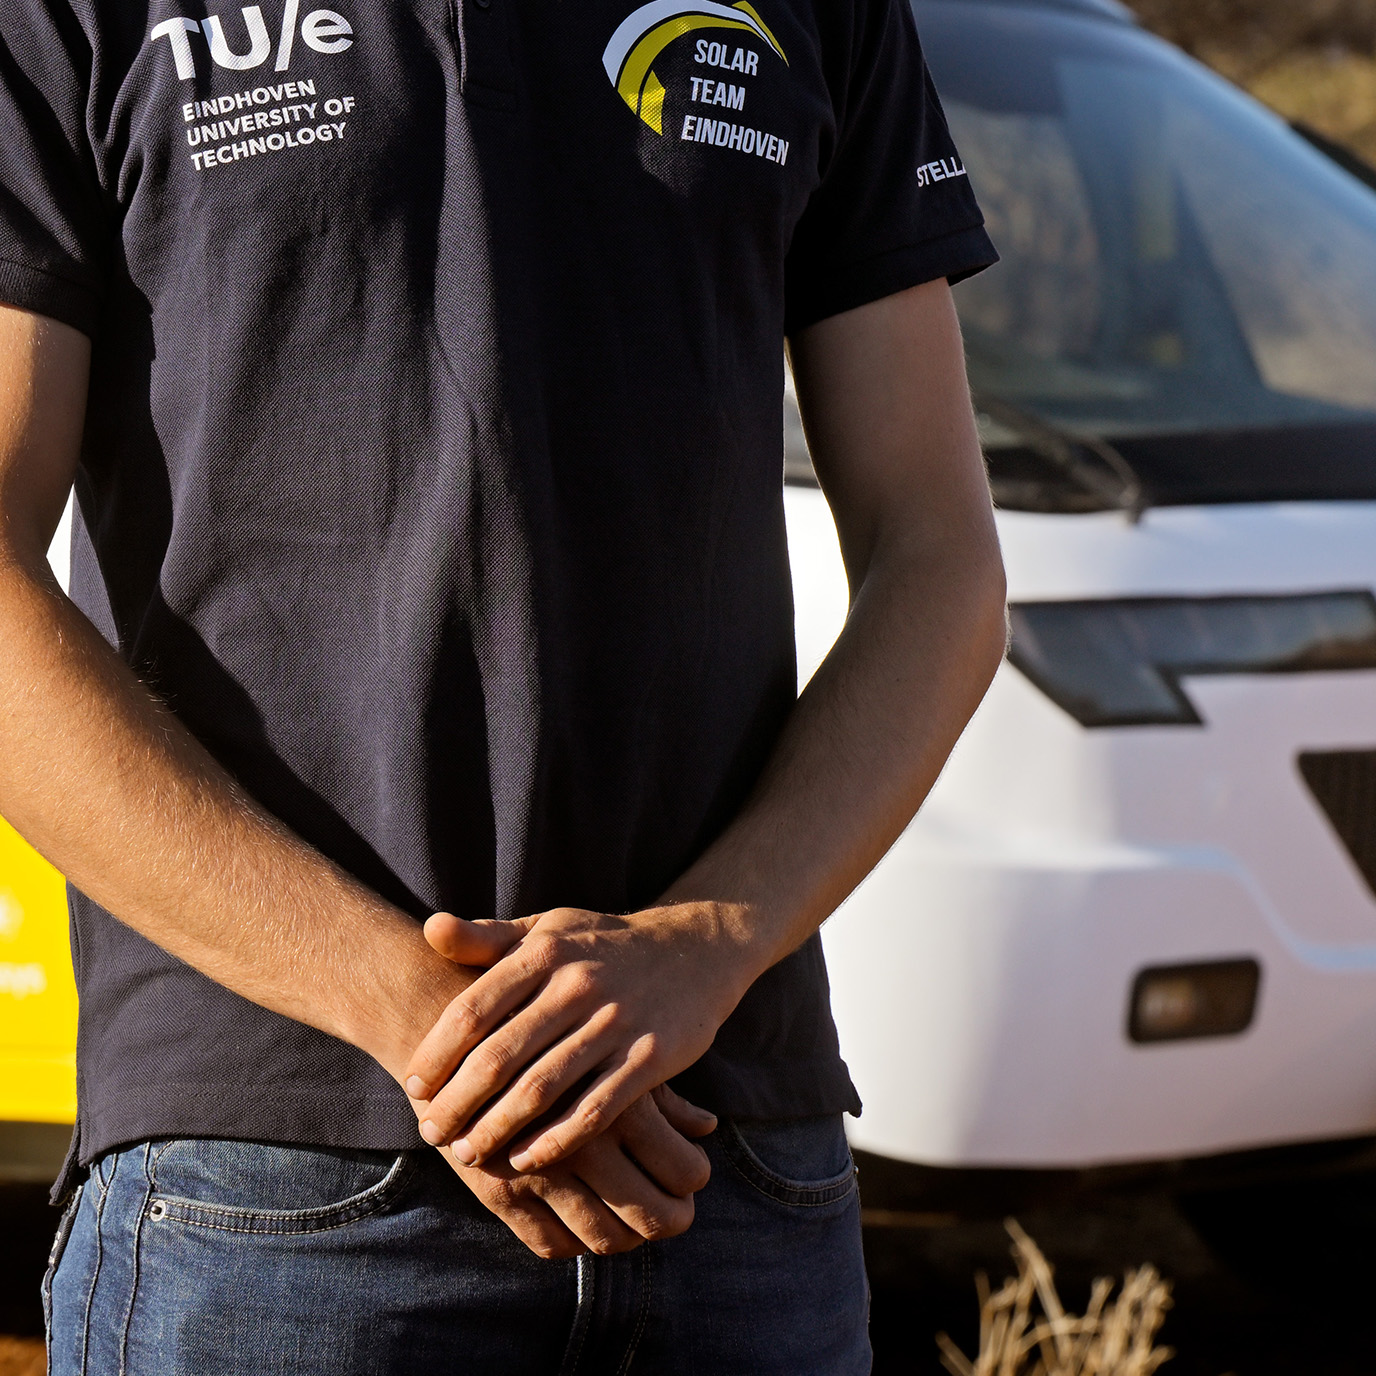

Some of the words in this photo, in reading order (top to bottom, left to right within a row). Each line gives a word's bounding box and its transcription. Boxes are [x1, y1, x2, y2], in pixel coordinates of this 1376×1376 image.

[694, 39, 759, 77] SOLAR
[183, 79, 316, 123] EINDHOVEN
[690, 76, 746, 112] TEAM
[187, 104, 317, 147] UNIVERSITY
[324, 96, 356, 115] OF
[681, 114, 790, 166] EINDHOVEN
[190, 121, 347, 171] TECHNOLOGY
